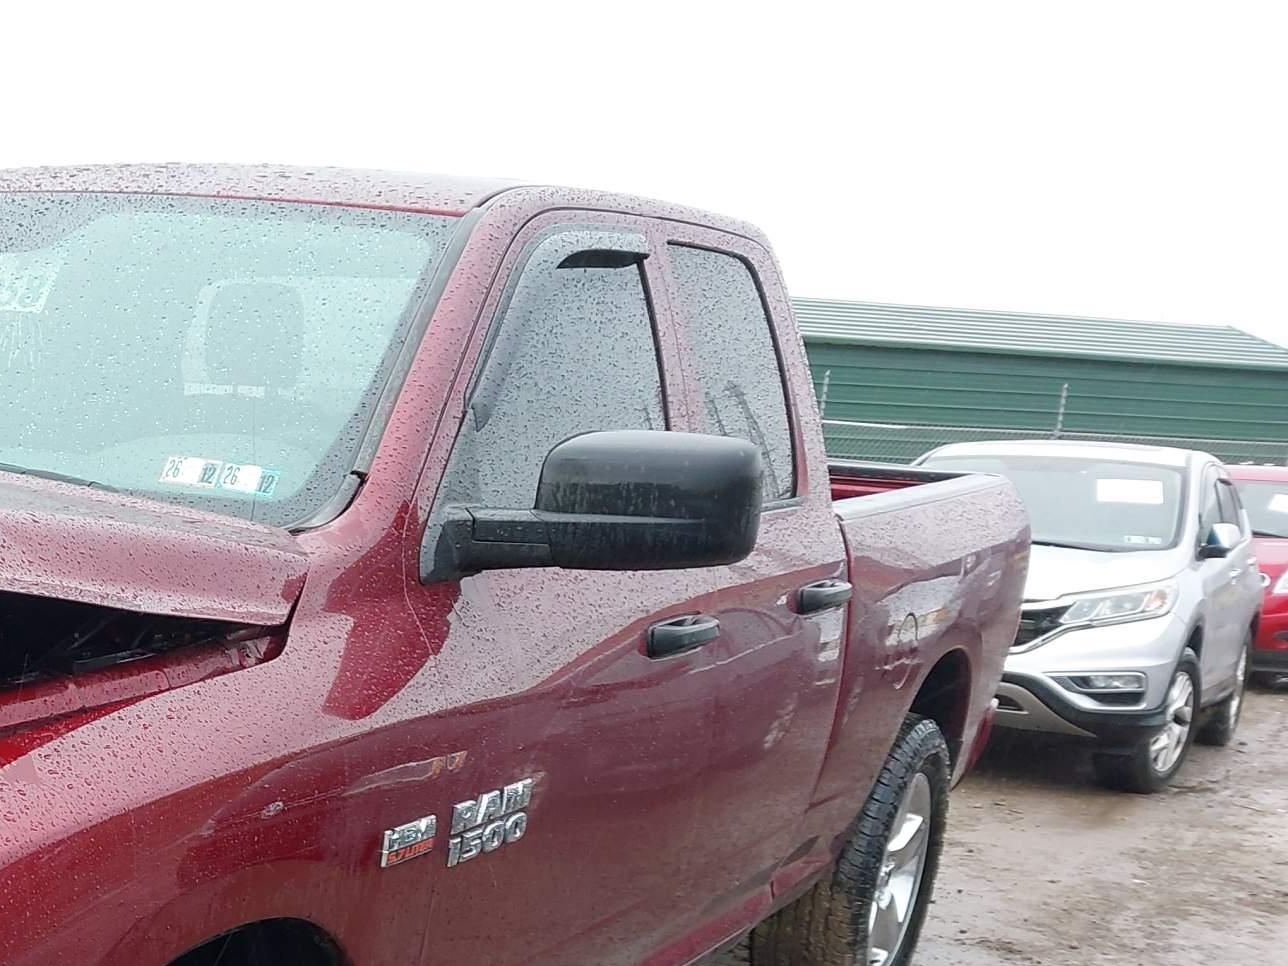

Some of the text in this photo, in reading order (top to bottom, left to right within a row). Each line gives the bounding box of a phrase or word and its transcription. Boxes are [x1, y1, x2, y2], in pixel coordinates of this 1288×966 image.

[165, 459, 217, 484] 26 12
[223, 466, 275, 494] 26 12
[451, 778, 534, 834] RAM
[447, 812, 528, 868] 1500
